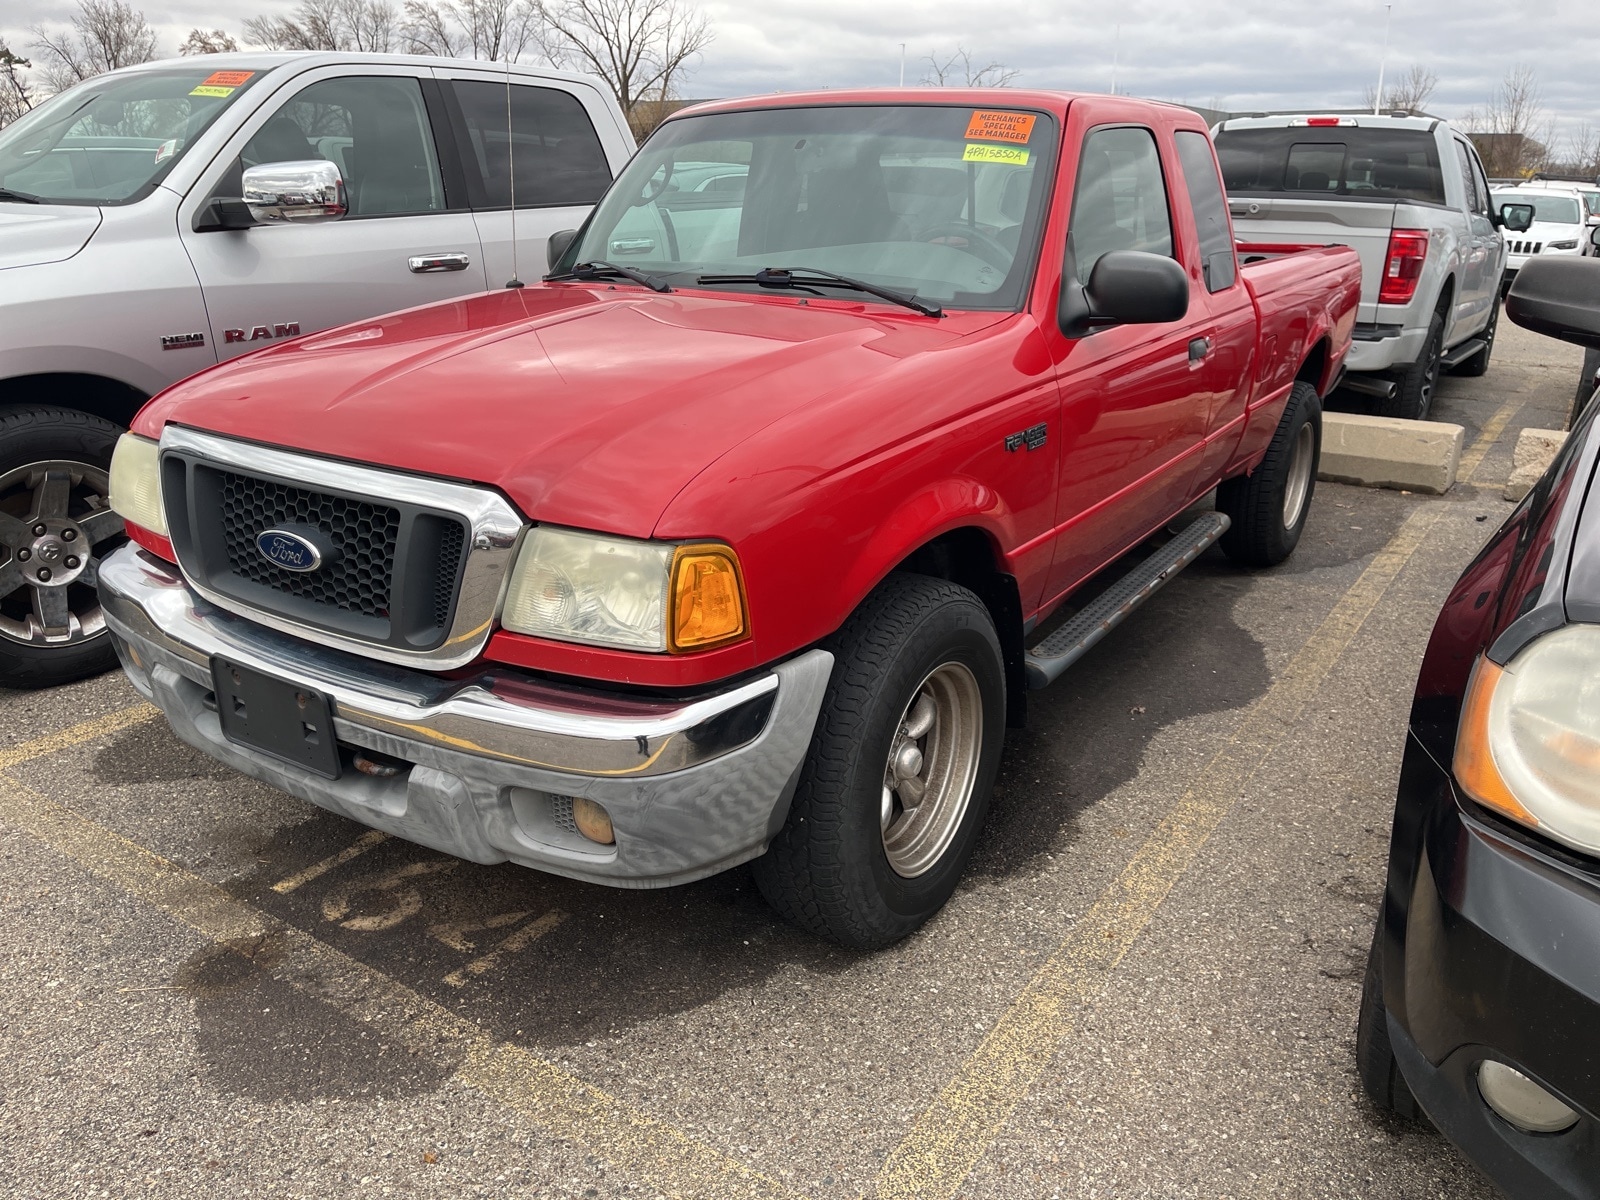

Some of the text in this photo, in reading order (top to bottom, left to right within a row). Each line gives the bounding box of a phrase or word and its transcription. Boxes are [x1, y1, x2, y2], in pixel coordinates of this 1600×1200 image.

[979, 113, 1027, 124] MECHANICS
[983, 121, 1017, 131] SPECIAL
[968, 128, 1027, 141] SEE MANAGER
[160, 332, 204, 345] HEMI
[223, 321, 300, 344] RAM
[270, 537, 304, 565] Ford
